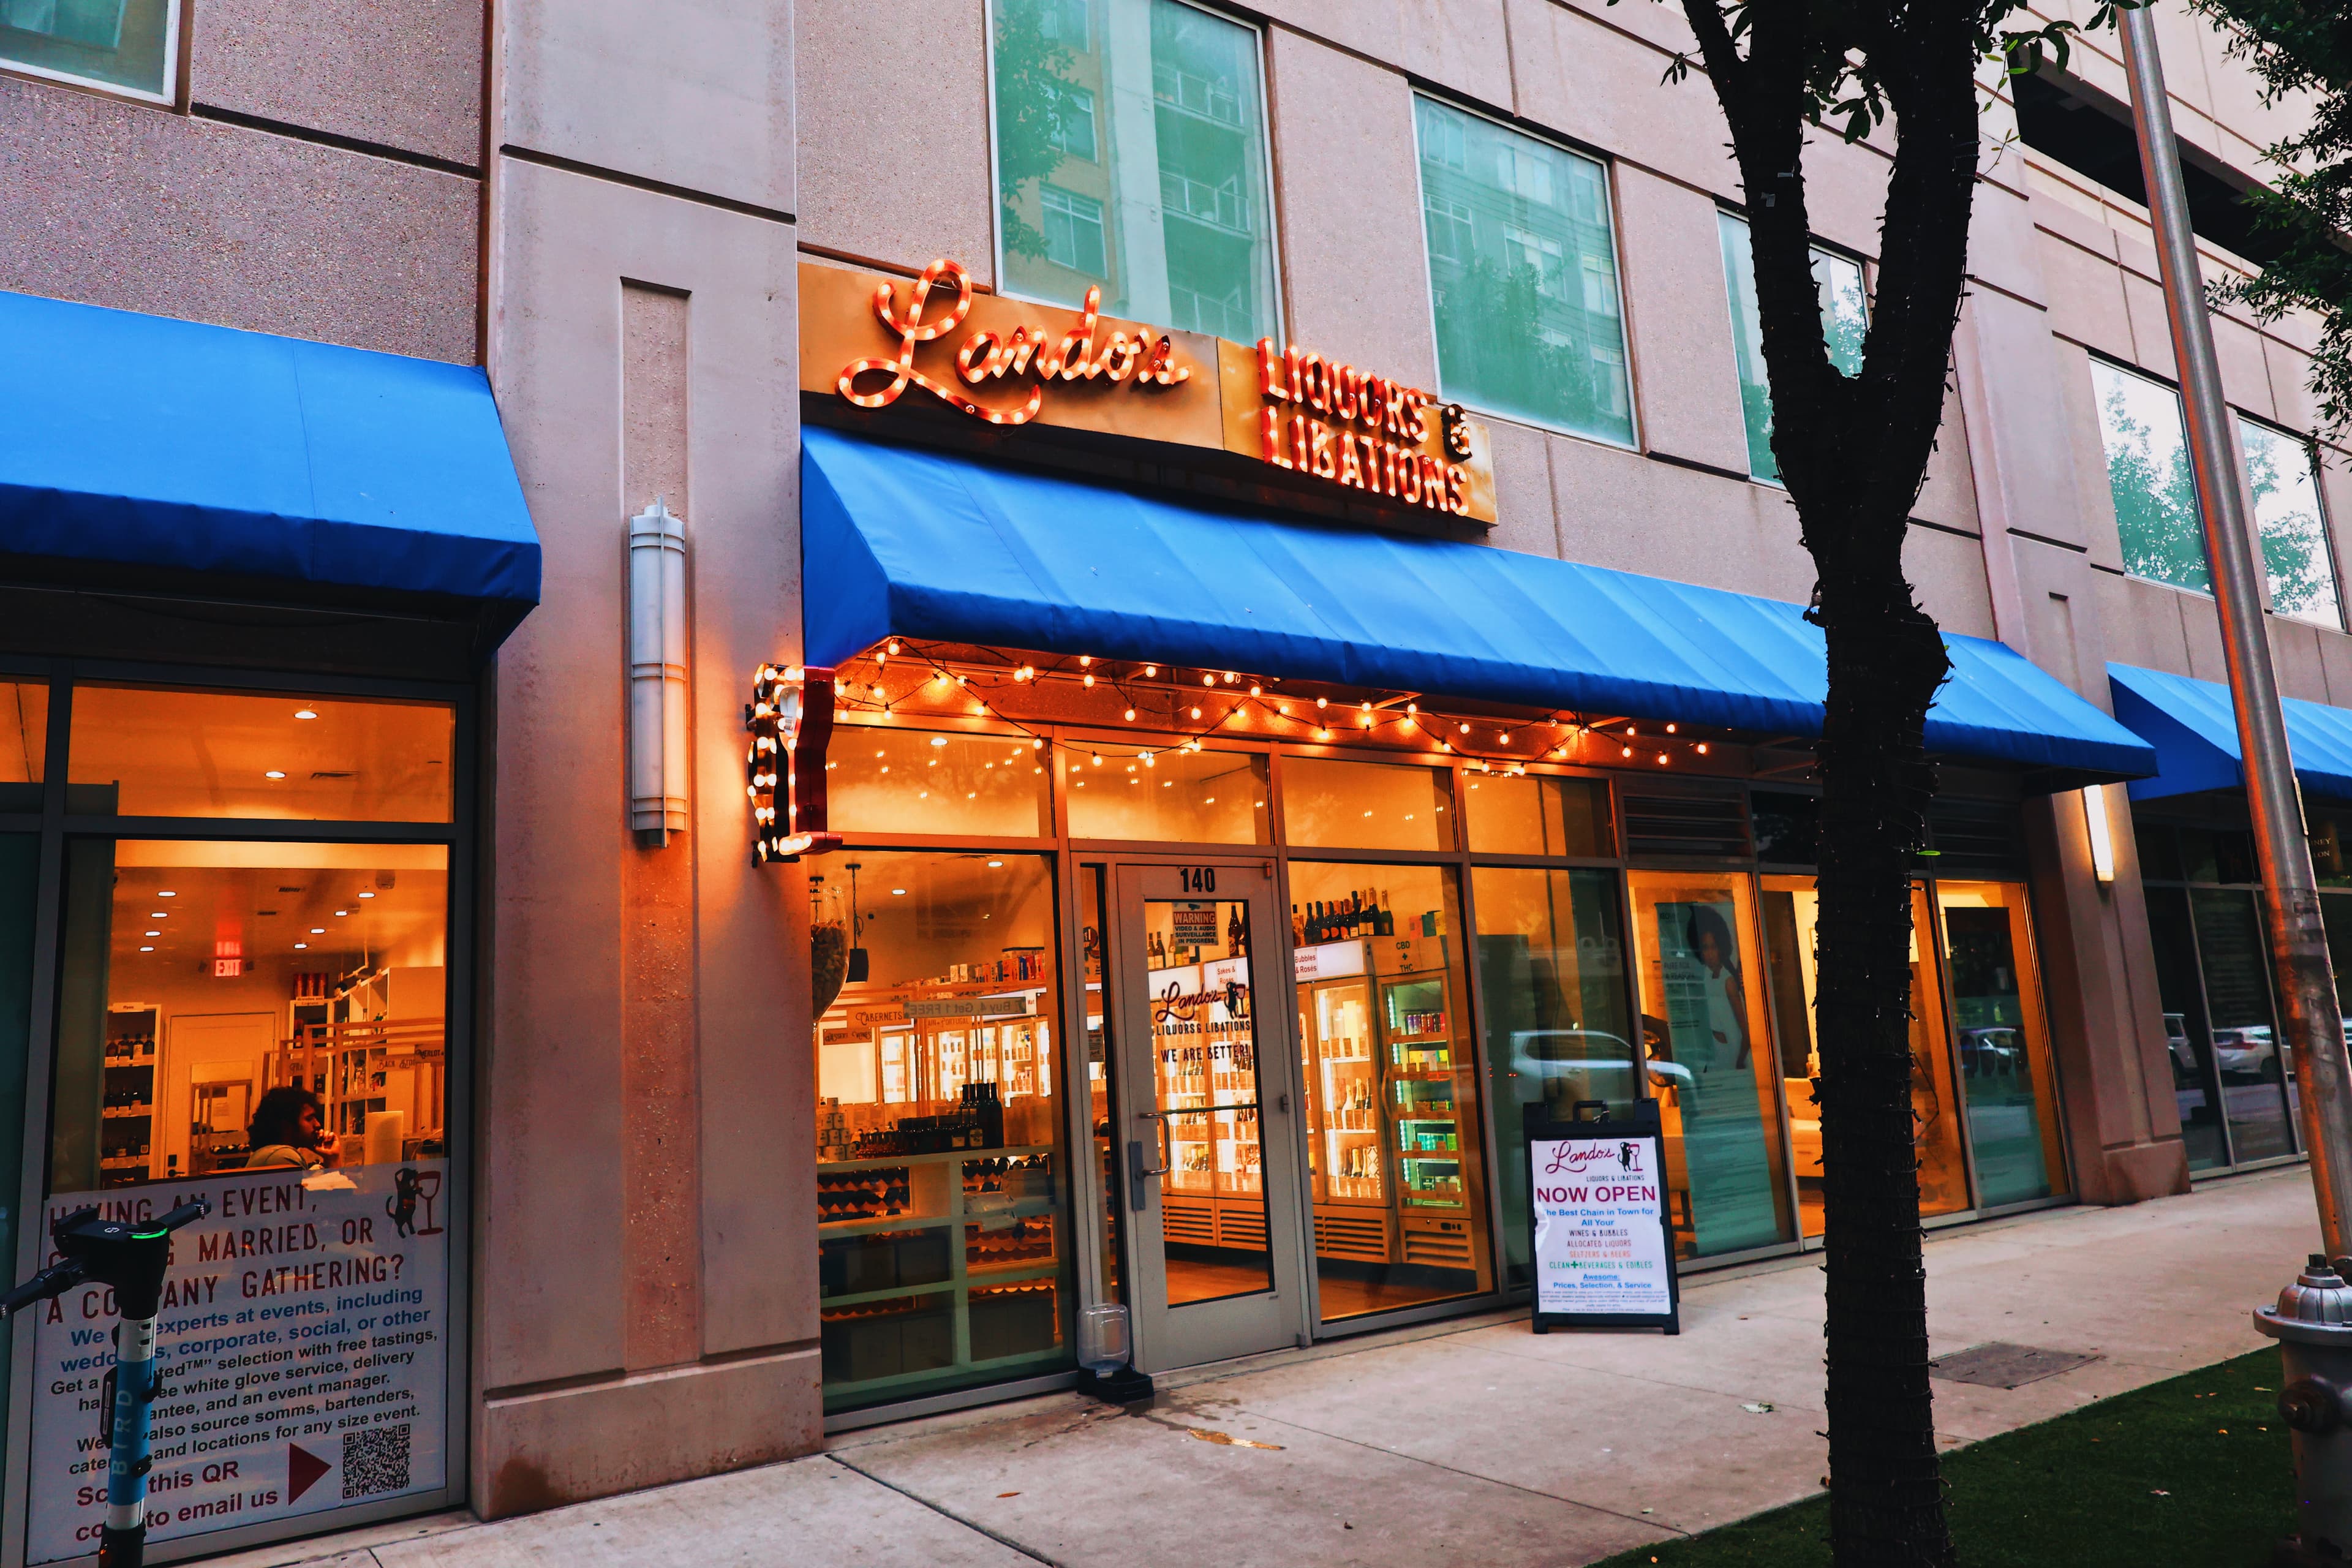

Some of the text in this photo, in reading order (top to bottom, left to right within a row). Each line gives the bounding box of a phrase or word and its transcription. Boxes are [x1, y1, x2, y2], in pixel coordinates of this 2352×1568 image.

[835, 257, 1194, 425] Lando's
[1257, 335, 1471, 461] LIQUORS &
[1261, 405, 1469, 517] LIBATIONS
[1180, 867, 1215, 892] 140
[1174, 912, 1215, 924] WARNING
[1294, 954, 1316, 963] Bubbles
[1396, 941, 1410, 949] CBD
[215, 959, 241, 976] EXIT
[1400, 963, 1414, 972] THC
[856, 1011, 902, 1025] CABERNETS
[1155, 981, 1221, 1022] Lando's
[1156, 1023, 1194, 1036] LIQUORS
[1205, 1020, 1250, 1033] LIBATIONS
[1161, 1044, 1250, 1062] WE ARE BETTER!
[1545, 1141, 1615, 1174] Lando's
[49, 1198, 152, 1236] HVING
[223, 1183, 317, 1218] EVENT,
[1537, 1186, 1656, 1202] NOW OPEN
[198, 1223, 326, 1262] MARRIED,
[342, 1217, 373, 1246] OR
[82, 1275, 218, 1319] COANY
[242, 1254, 404, 1298] GATHERING?
[71, 1289, 423, 1346] We experts at events, including
[179, 1329, 282, 1355] corporate,
[289, 1318, 351, 1340] social,
[358, 1316, 377, 1330] or
[382, 1310, 431, 1327] other
[51, 1379, 83, 1395] Get
[89, 1379, 99, 1390] a
[217, 1350, 293, 1370] selection
[298, 1342, 331, 1358] with
[337, 1339, 367, 1352] free
[372, 1330, 438, 1348] tastings,
[184, 1378, 229, 1395] white
[235, 1371, 280, 1390] glove
[285, 1361, 349, 1378] service,
[353, 1351, 415, 1370] delivery
[206, 1394, 237, 1411] and
[243, 1393, 263, 1405] an
[268, 1383, 313, 1400] event
[318, 1373, 391, 1393] manager.
[111, 1390, 133, 1476] BIRD
[148, 1424, 185, 1441] also
[191, 1414, 249, 1434] source
[255, 1404, 320, 1423] somms,
[325, 1389, 415, 1412] bartenders,
[154, 1442, 186, 1460] and
[192, 1431, 270, 1454] locations
[276, 1425, 298, 1439] for
[304, 1420, 333, 1434] any
[337, 1414, 369, 1428] size
[374, 1404, 420, 1423] event.
[148, 1471, 193, 1493] this
[202, 1460, 239, 1483] QR
[146, 1509, 170, 1528] to
[178, 1492, 242, 1521] email
[251, 1490, 279, 1508] us
